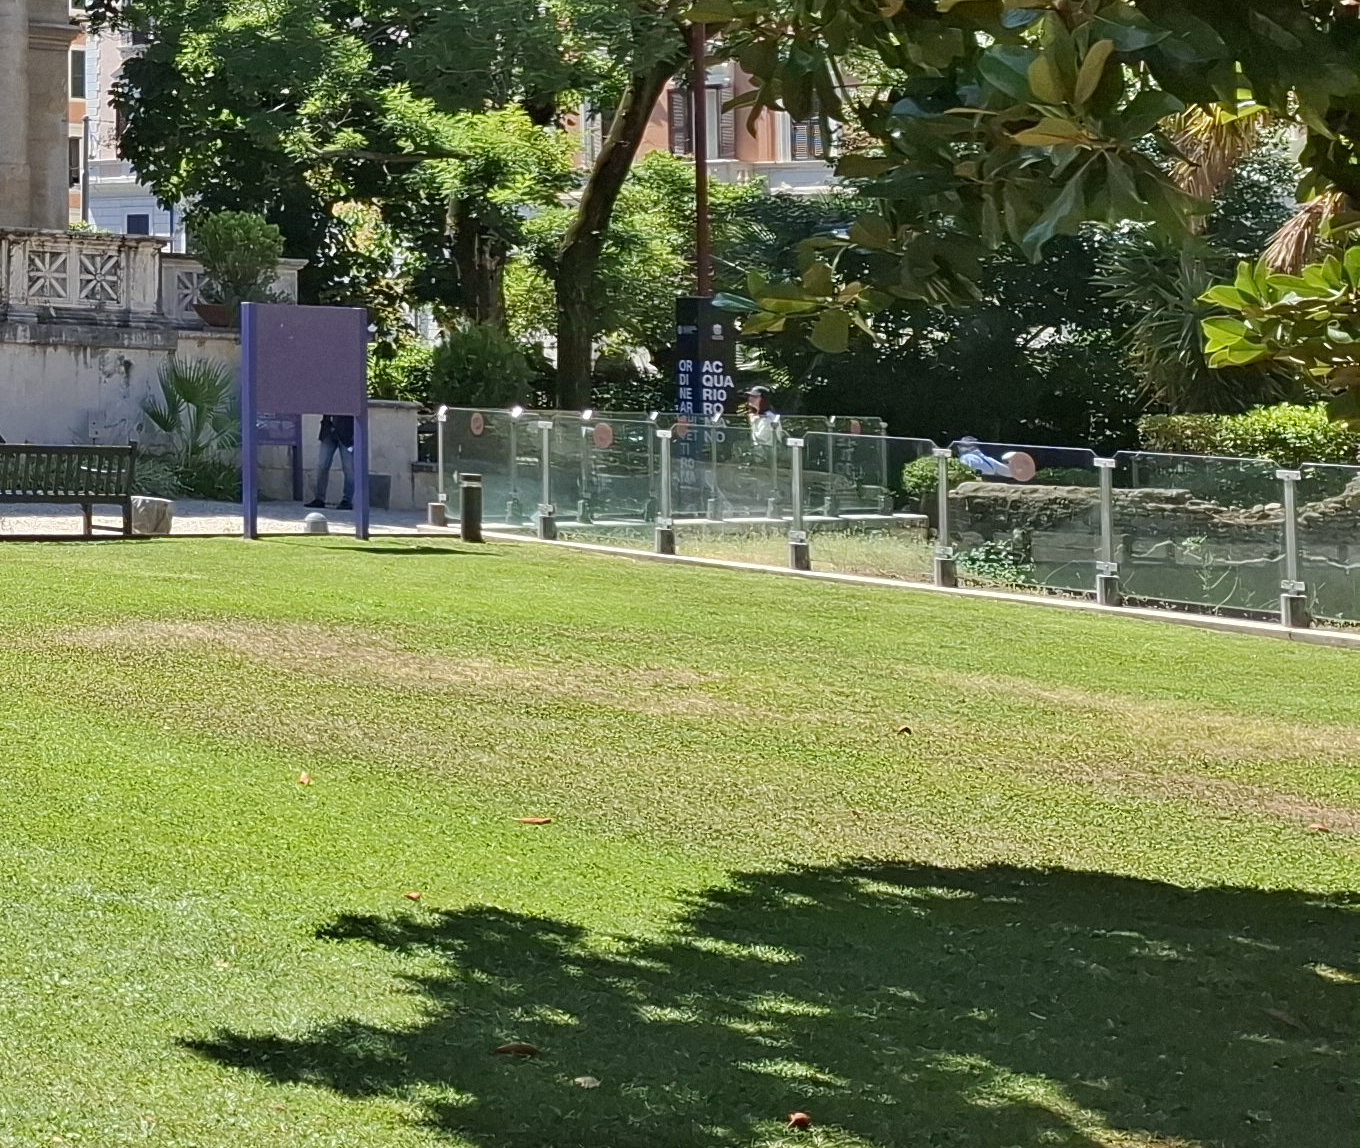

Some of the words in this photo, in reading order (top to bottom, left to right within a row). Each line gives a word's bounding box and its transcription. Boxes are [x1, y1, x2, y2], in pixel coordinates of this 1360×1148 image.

[678, 359, 693, 372] OR
[702, 360, 724, 373] AC
[679, 373, 689, 386] DI
[702, 374, 735, 388] QUA
[679, 387, 693, 400] NE
[702, 388, 727, 402] RIO
[679, 401, 693, 414] AR
[703, 402, 724, 415] RO
[704, 430, 726, 443] NO
